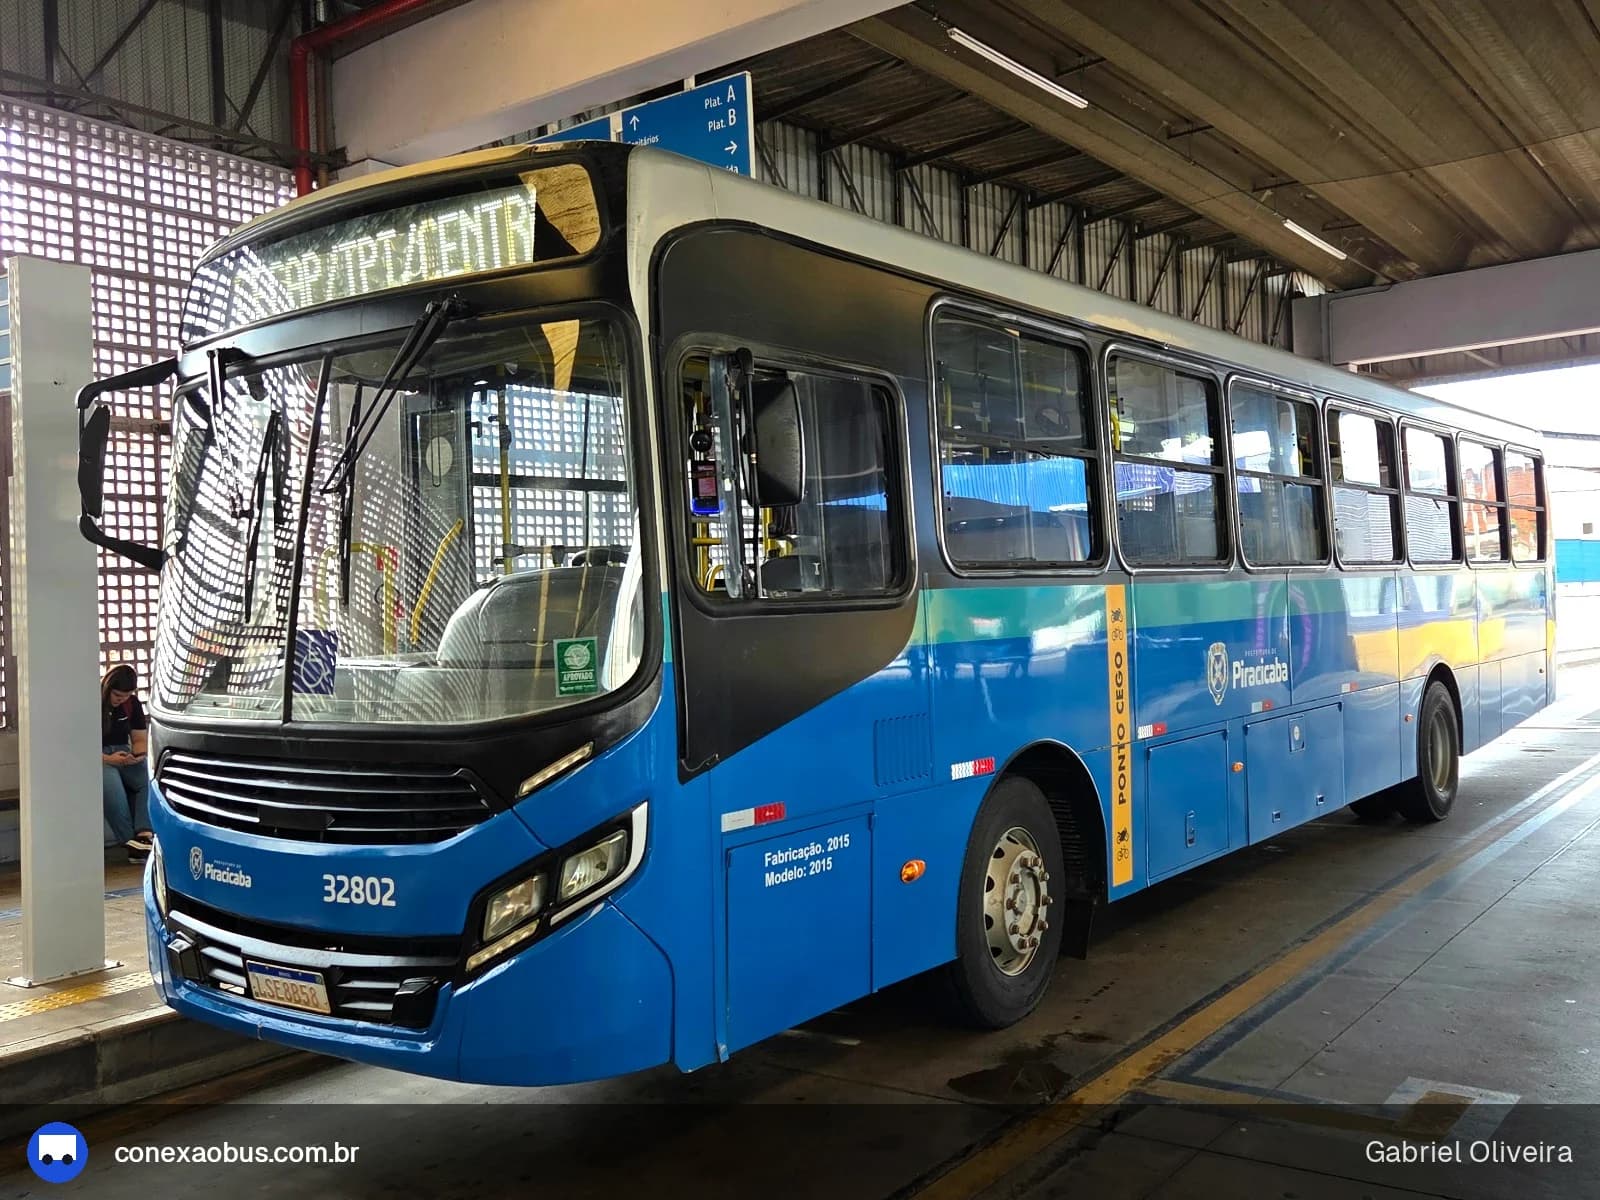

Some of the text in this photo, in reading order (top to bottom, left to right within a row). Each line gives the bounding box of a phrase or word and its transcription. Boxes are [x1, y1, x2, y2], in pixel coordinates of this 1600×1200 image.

[704, 84, 736, 109] Plat. A
[708, 108, 737, 132] Plat. B
[1232, 656, 1289, 689] Piracicaba
[1115, 651, 1127, 805] PONTO CEGO
[827, 833, 850, 852] 2015
[205, 863, 252, 888] Piracicaba
[764, 857, 833, 888] Modelo: 2015
[322, 873, 396, 907] 32802
